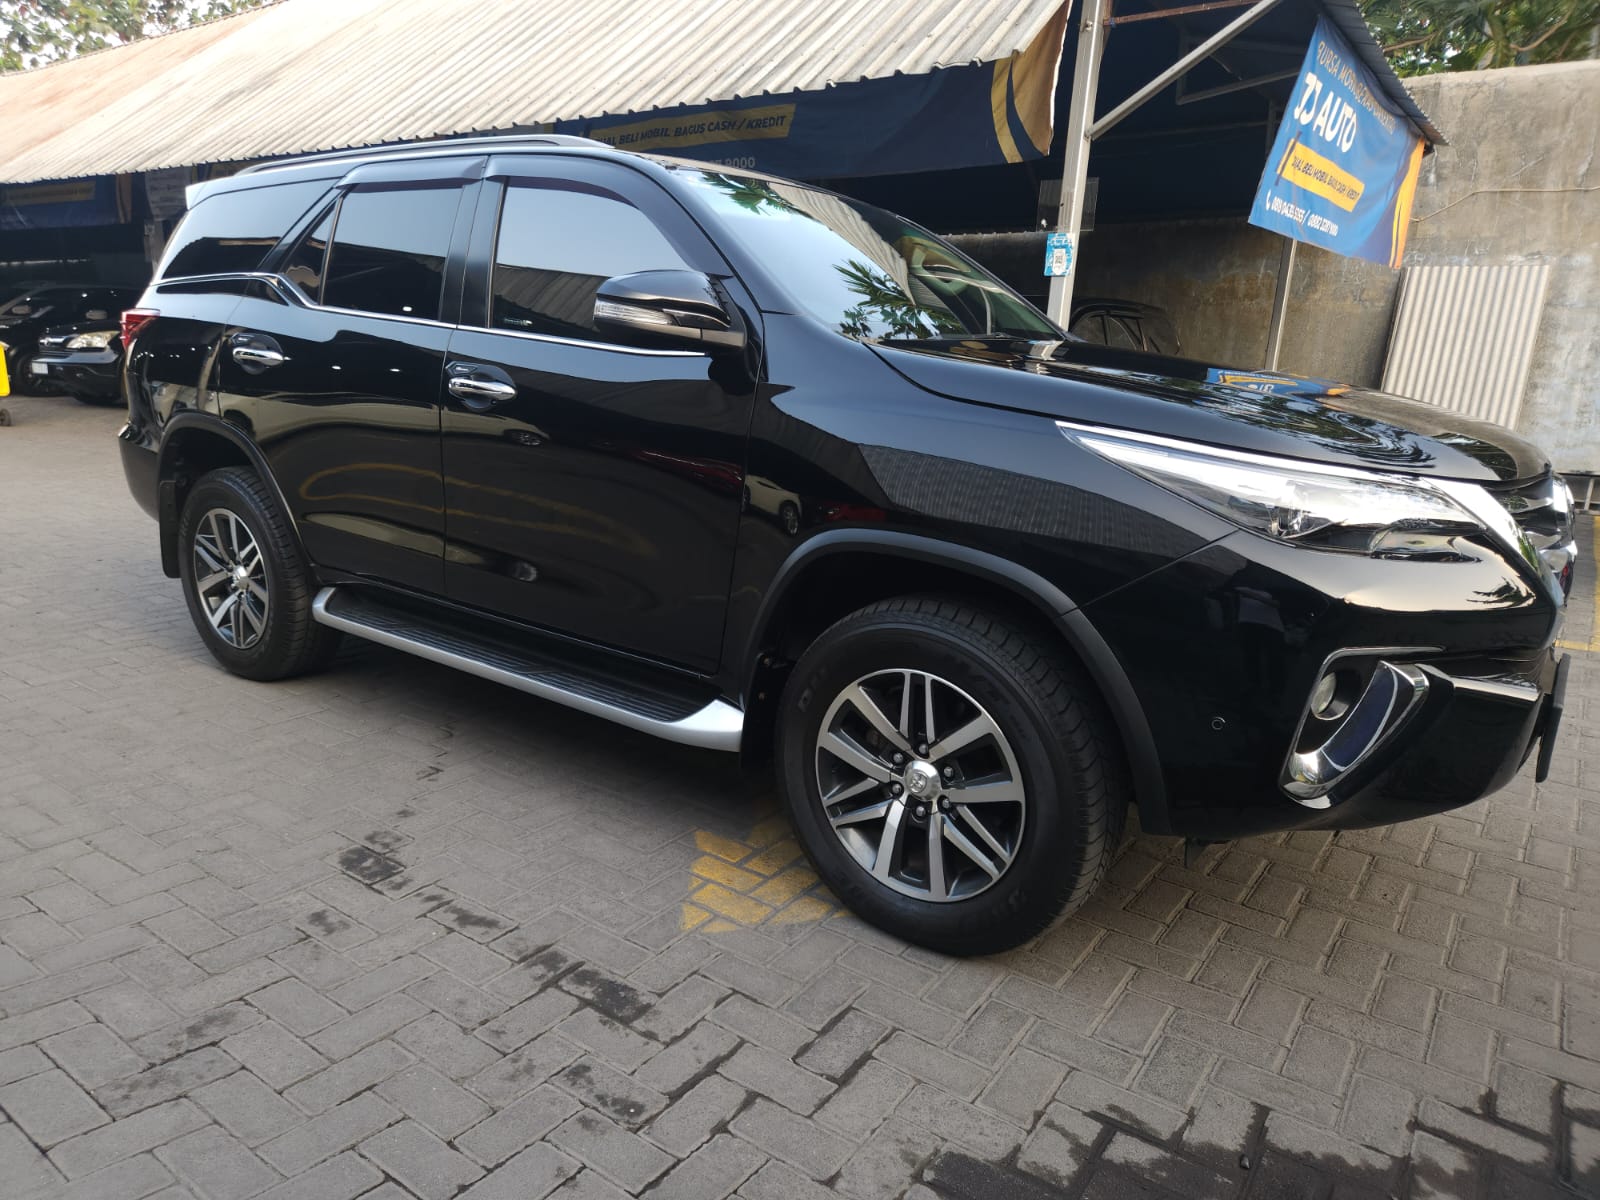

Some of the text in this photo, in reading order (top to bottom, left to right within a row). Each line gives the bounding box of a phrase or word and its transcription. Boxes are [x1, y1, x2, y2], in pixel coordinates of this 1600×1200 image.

[619, 133, 639, 145] BELI
[640, 127, 670, 140] MOBIL
[674, 122, 706, 137] BAGUS
[707, 118, 738, 132] CASH
[746, 115, 786, 129] KREDIT
[1312, 90, 1357, 152] AUTO
